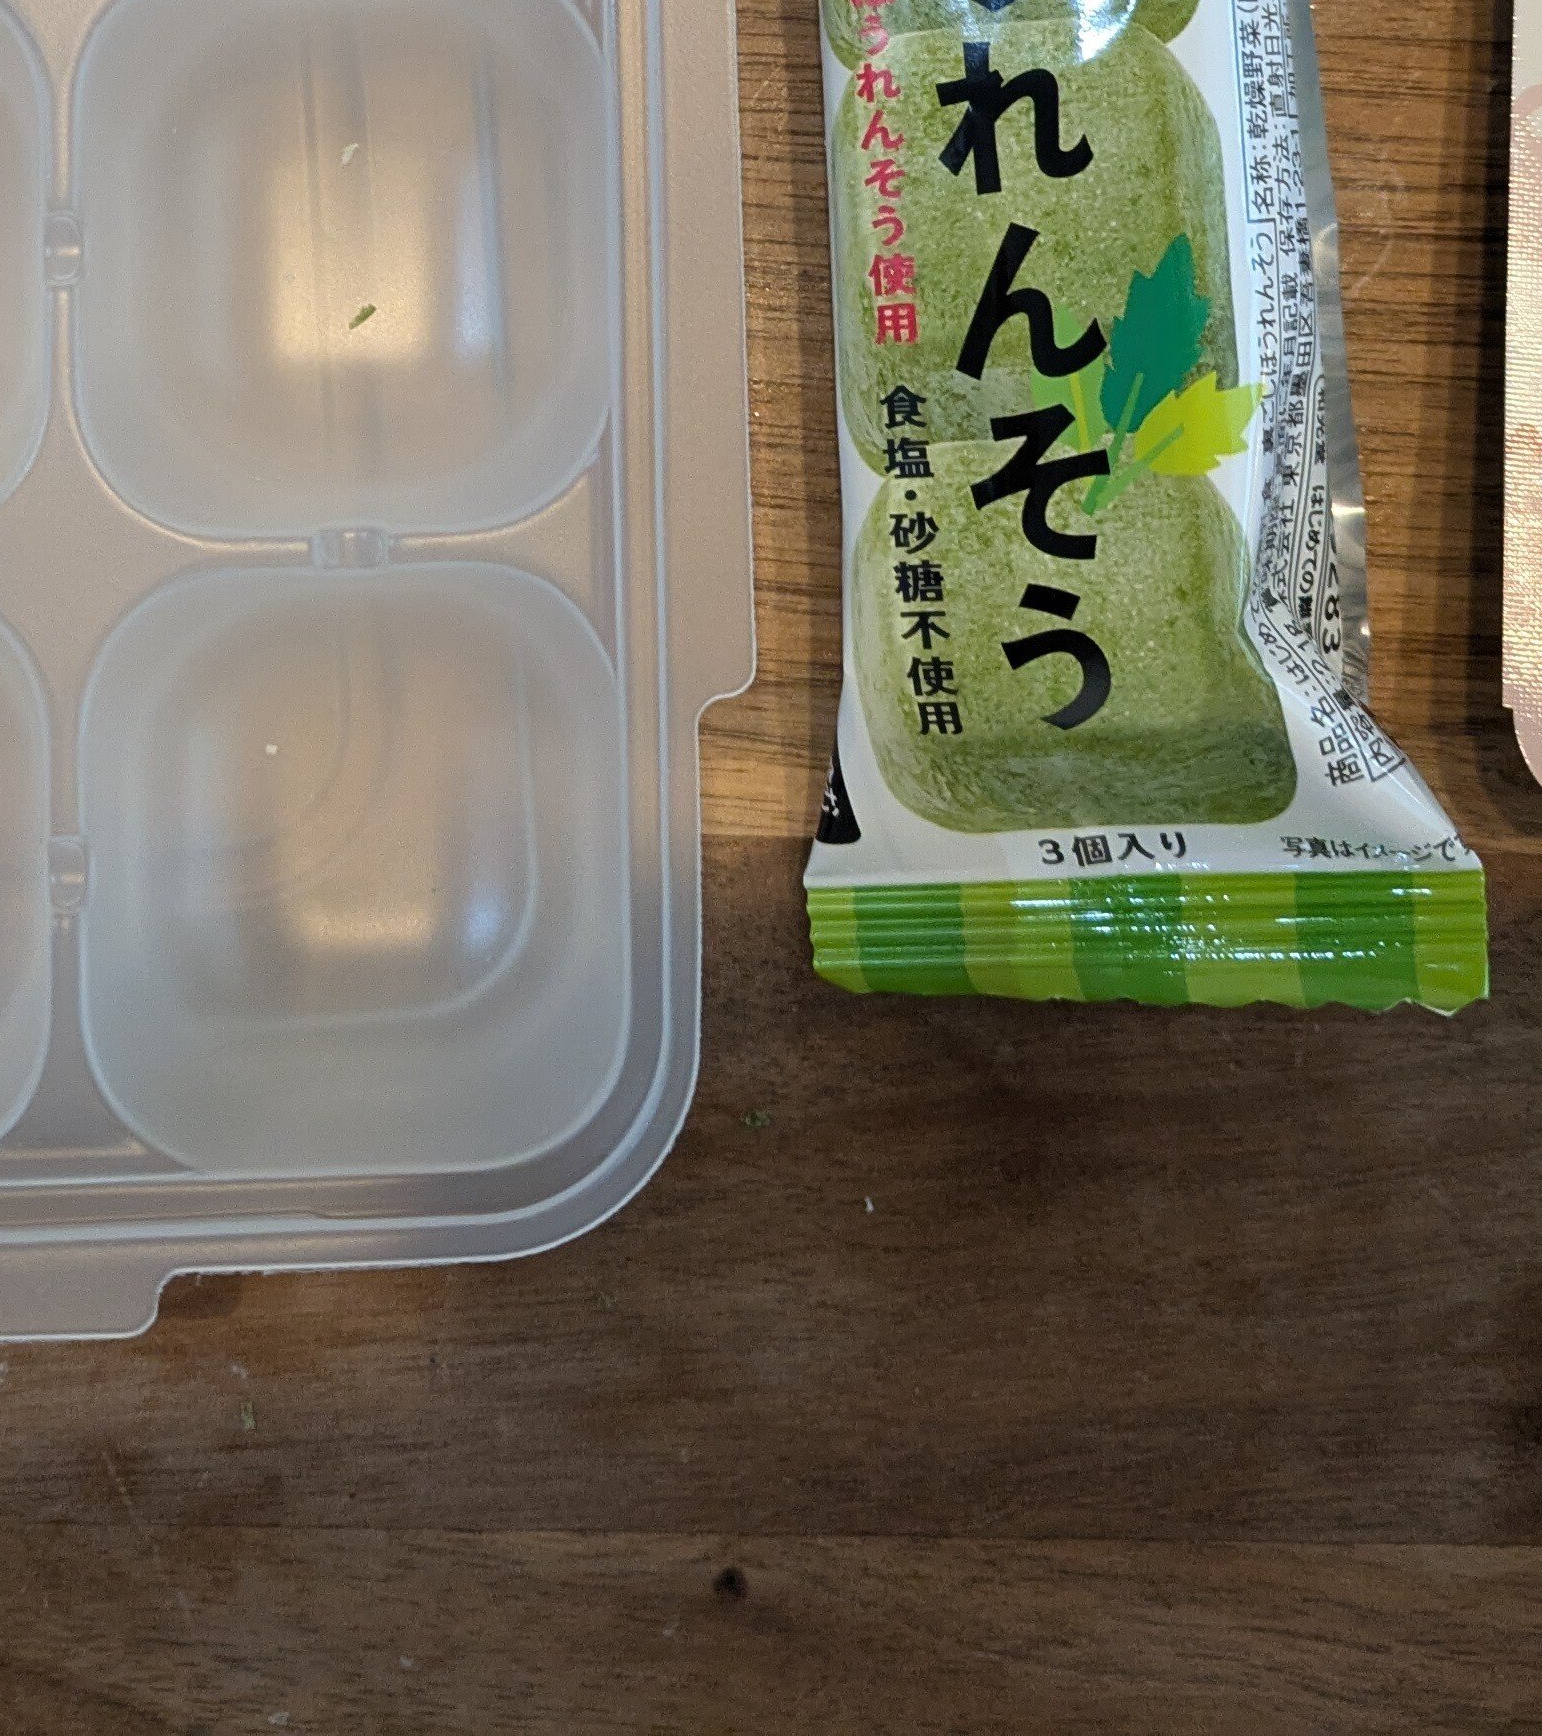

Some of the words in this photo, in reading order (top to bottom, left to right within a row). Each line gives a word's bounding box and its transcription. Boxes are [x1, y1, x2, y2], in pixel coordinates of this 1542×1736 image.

[878, 383, 964, 737] 食塩・砂糖不使用
[1037, 830, 1188, 869] 3個入り
